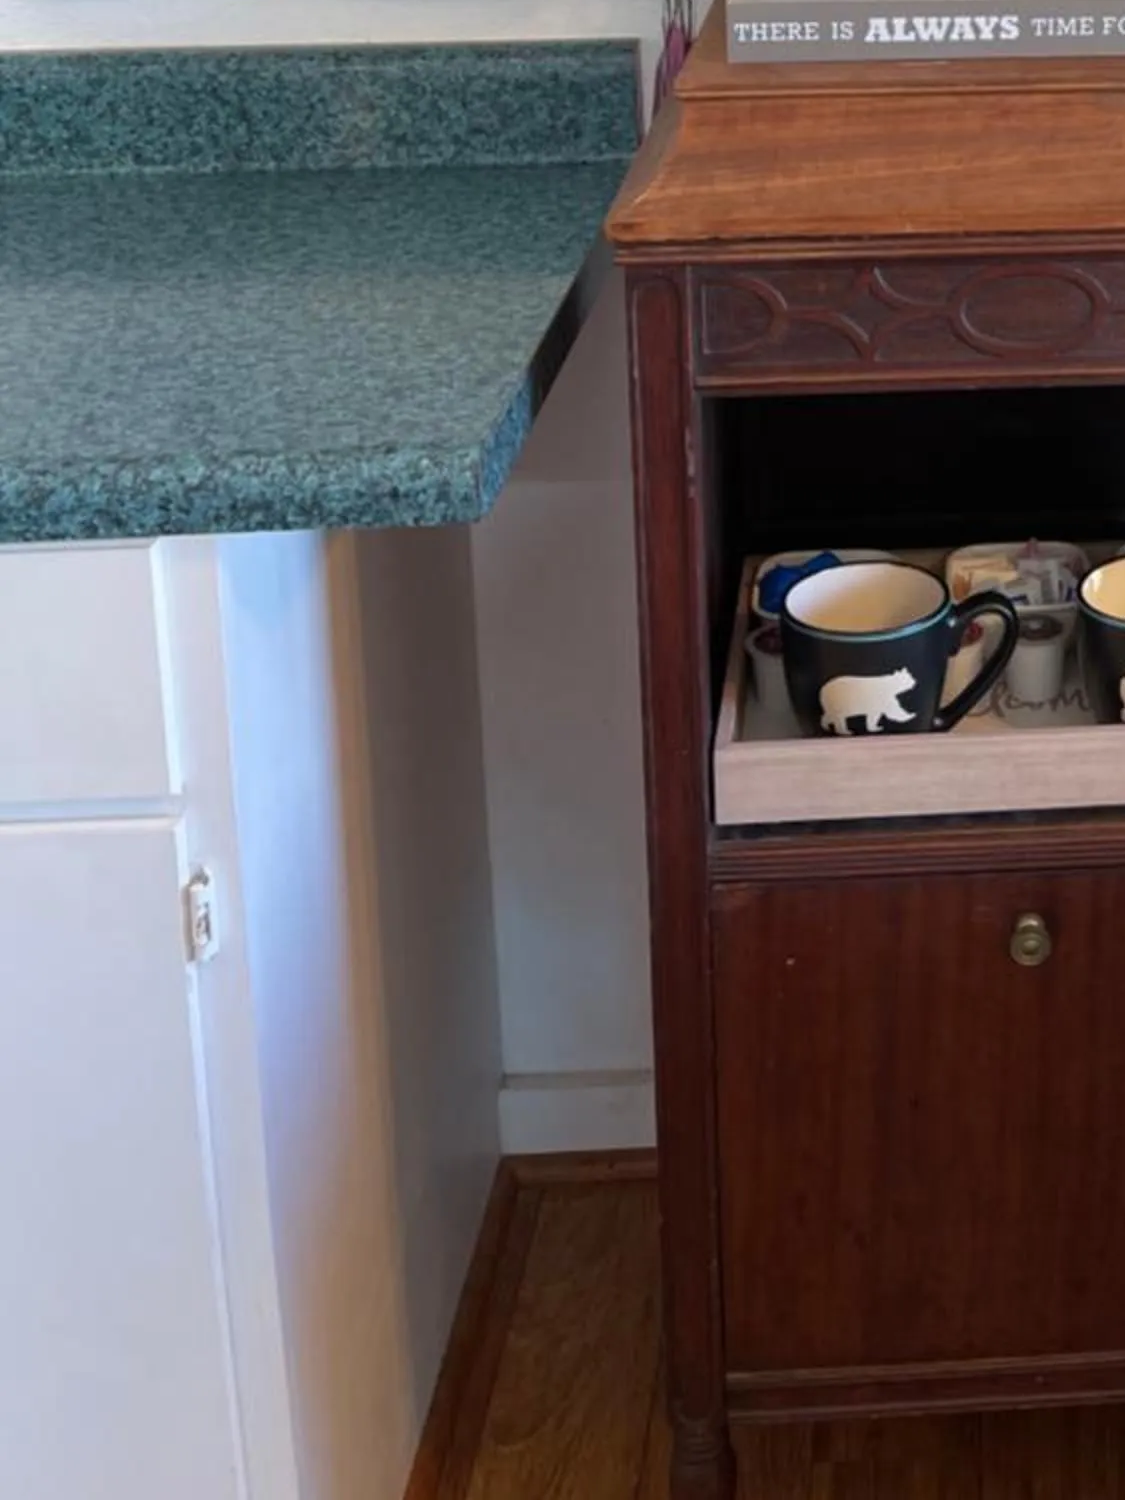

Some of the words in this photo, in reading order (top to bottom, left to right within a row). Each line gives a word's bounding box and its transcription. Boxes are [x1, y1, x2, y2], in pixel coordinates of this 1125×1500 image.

[733, 21, 819, 42] THERE
[831, 21, 854, 41] IS
[864, 15, 1020, 42] ALWAYS
[1031, 17, 1095, 37] TIME
